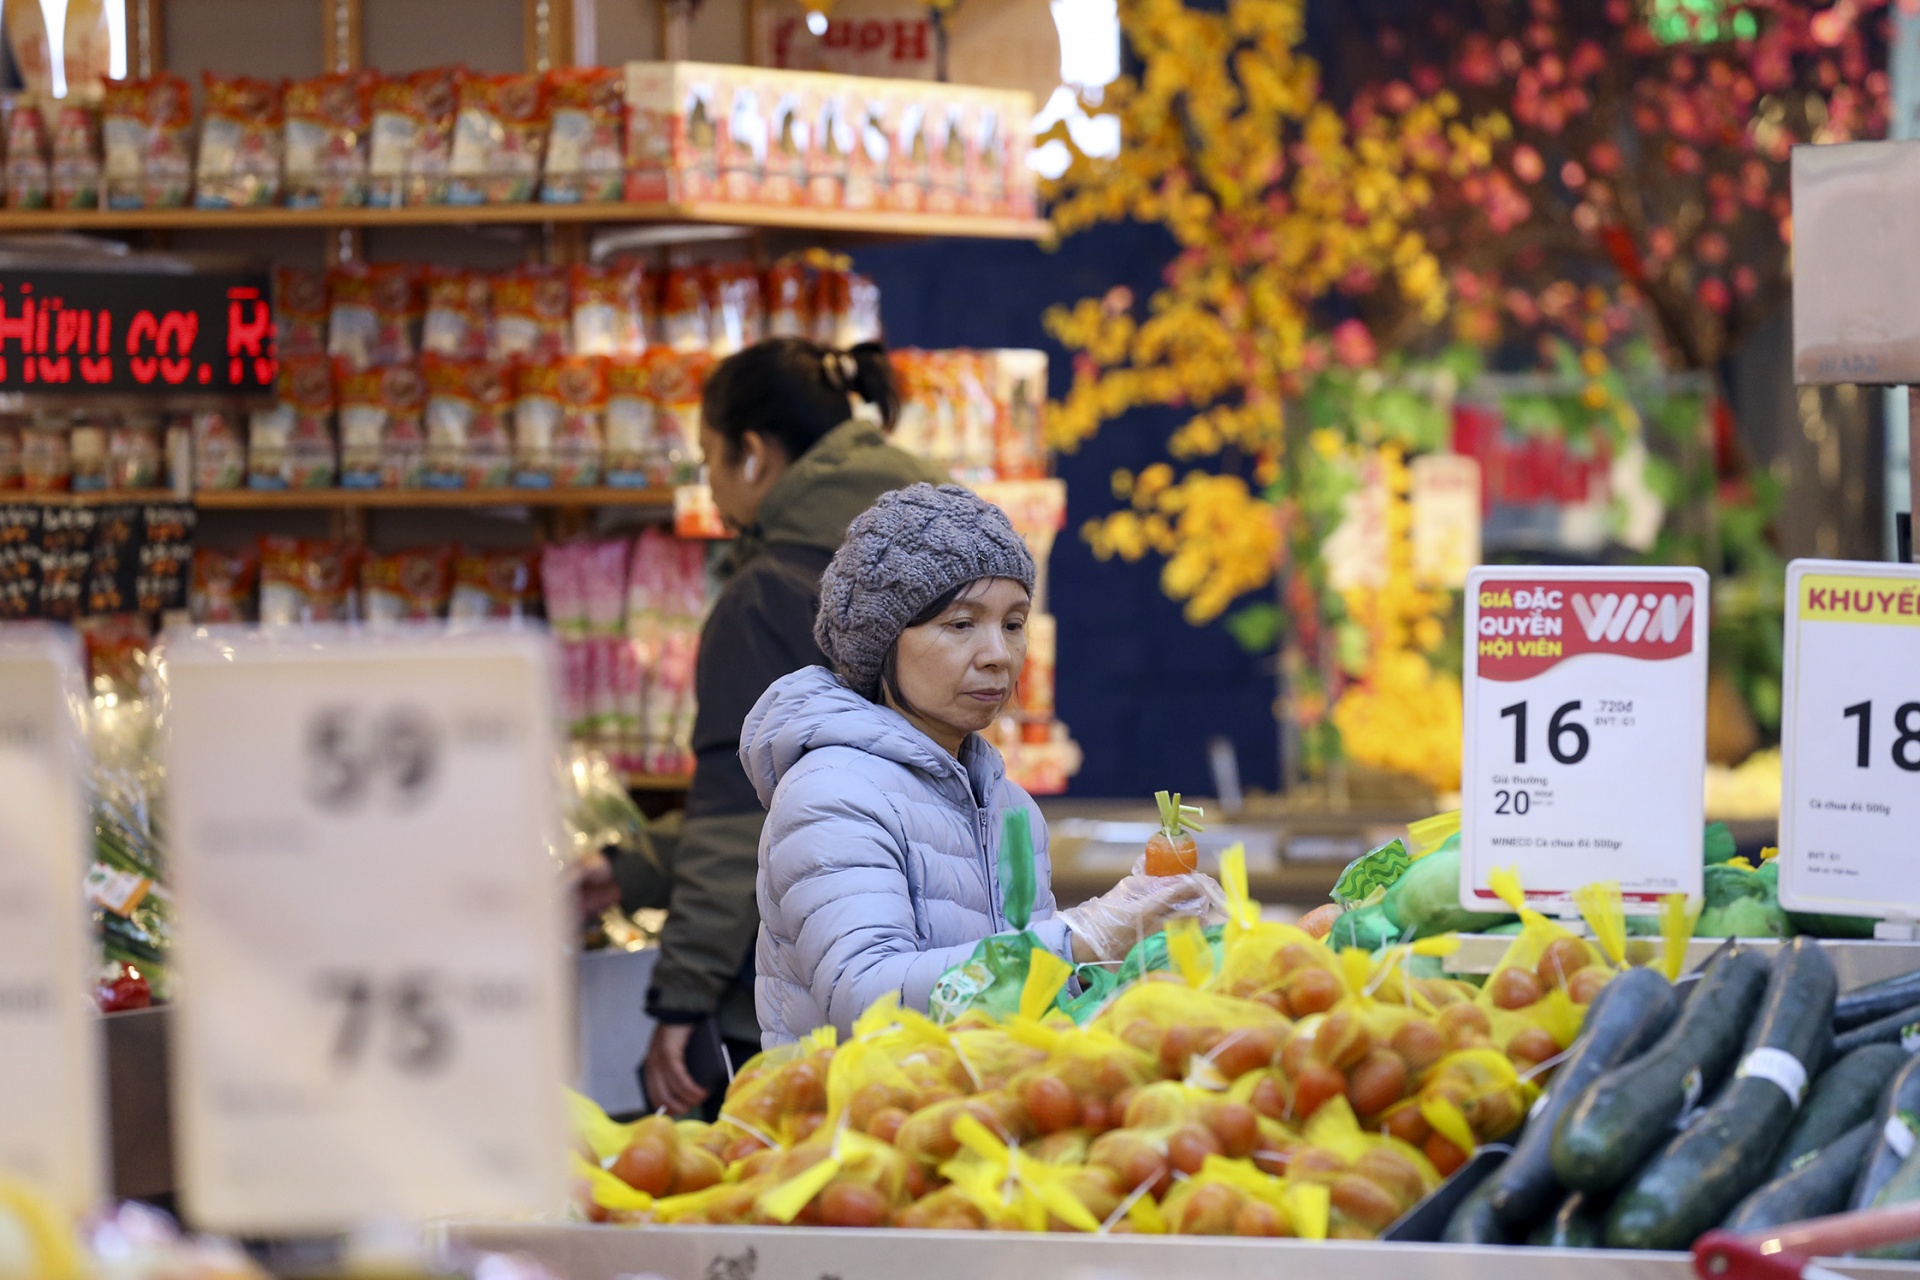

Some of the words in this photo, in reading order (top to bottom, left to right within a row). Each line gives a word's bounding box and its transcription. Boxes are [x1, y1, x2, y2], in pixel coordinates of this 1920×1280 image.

[1479, 588, 1513, 608] GIÁ
[1514, 586, 1563, 611] ĐẶC
[1808, 584, 1920, 616] KHUYẾ
[1479, 609, 1562, 636] QUYỀN
[1479, 637, 1513, 660] HỘI
[1517, 638, 1562, 657] VIÊN
[1500, 700, 1590, 765] 16
[1495, 790, 1530, 815] 20
[1551, 838, 1575, 848] chua
